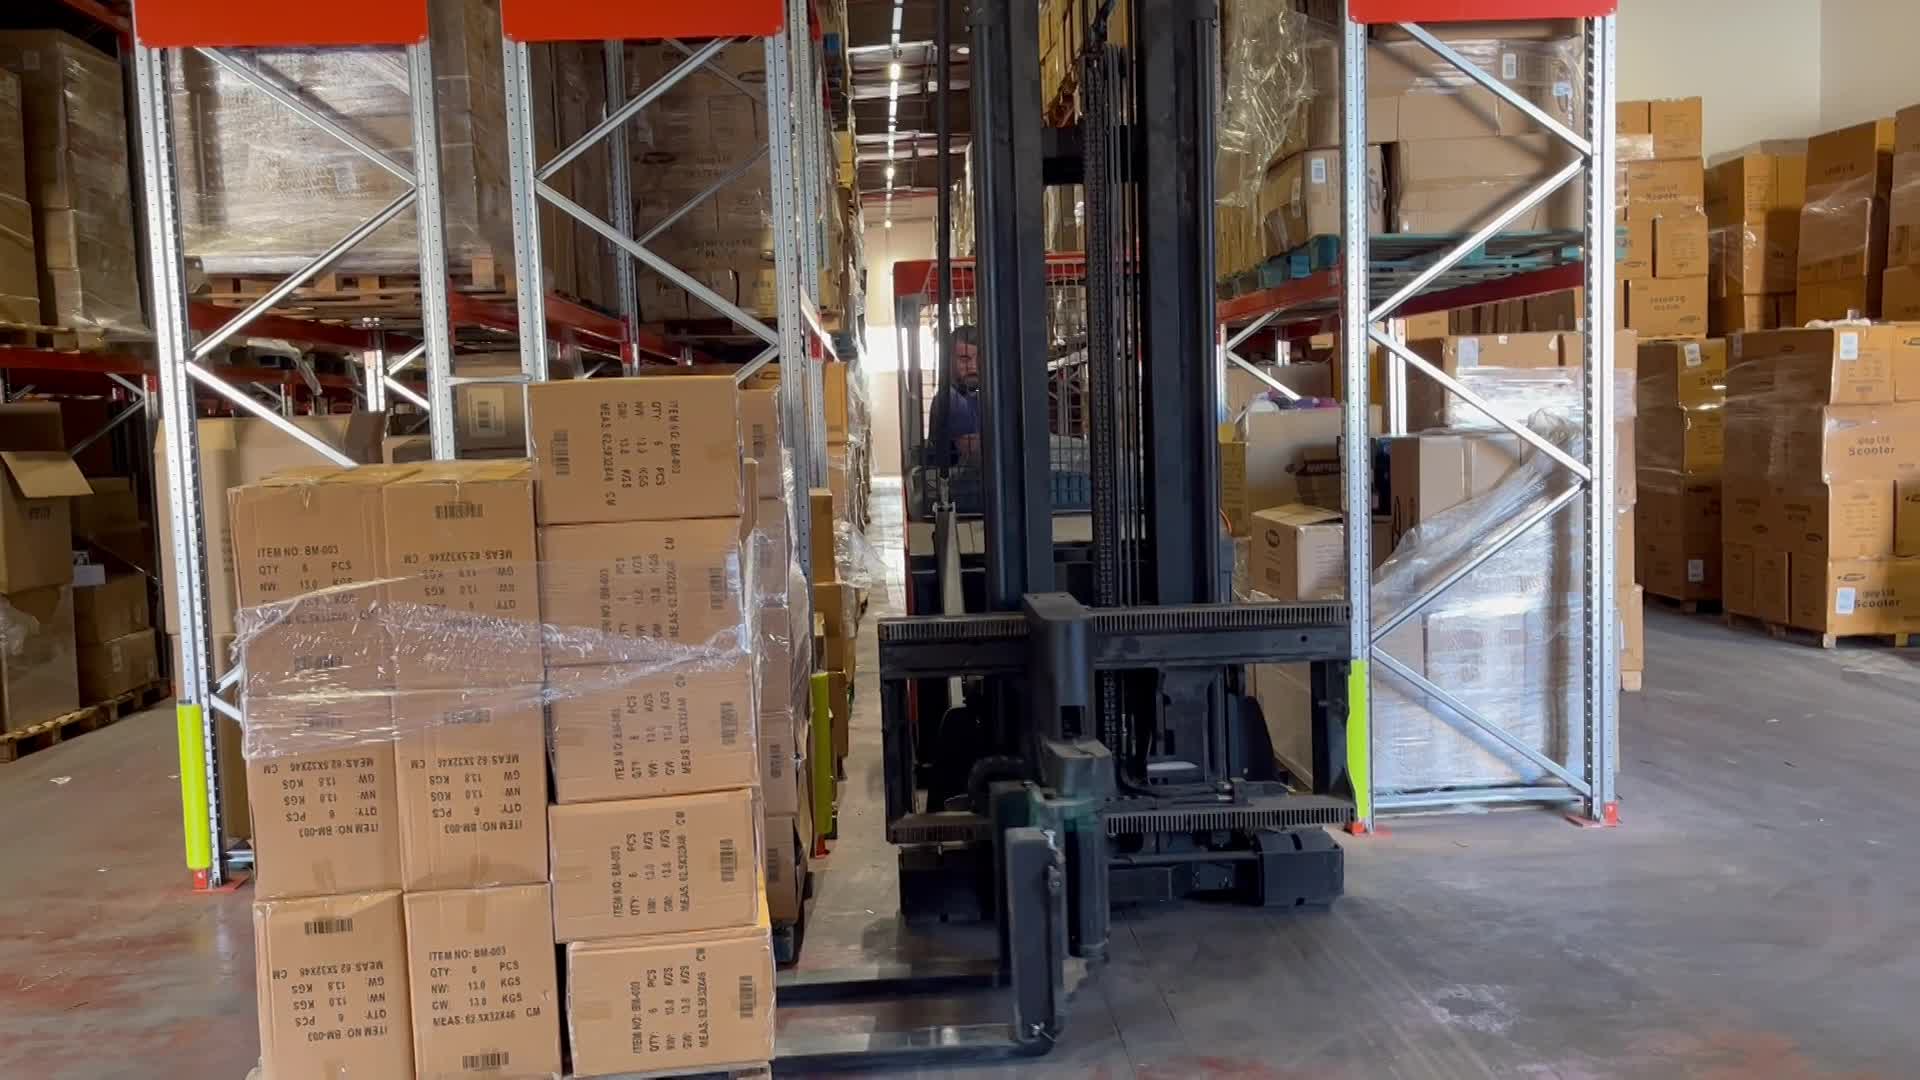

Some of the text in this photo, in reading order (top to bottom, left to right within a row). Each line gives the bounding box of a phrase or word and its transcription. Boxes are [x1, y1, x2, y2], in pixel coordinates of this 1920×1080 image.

[1848, 446, 1895, 456] Scooter
[258, 549, 281, 557] ITEM
[404, 554, 418, 563] CM
[331, 561, 352, 570] PCS
[424, 586, 445, 597] KGS
[1854, 599, 1903, 608] Scooter
[263, 764, 278, 774] CM
[411, 759, 425, 769] CM
[429, 776, 450, 785] KGS
[464, 773, 481, 783] 13.8
[282, 779, 303, 789] KGS
[320, 793, 337, 803] 13.0
[430, 791, 451, 801] KGS
[465, 789, 482, 800] 13.0
[283, 795, 305, 805] KGS
[432, 808, 452, 817] PCS
[474, 807, 480, 815] 6
[286, 812, 306, 822] PCS
[675, 811, 685, 825] CM
[335, 825, 352, 834] NO:
[355, 823, 378, 833] ITEM
[444, 820, 522, 833] ITEM NO: BM-003
[626, 833, 637, 852] PCS
[613, 896, 624, 917] ITEM
[429, 946, 506, 961] ITEM NO: BM-003
[499, 961, 519, 971] PCS
[273, 969, 287, 979] CM
[647, 969, 657, 988] PCS
[291, 984, 313, 993] KGS
[328, 982, 345, 990] 13.8
[468, 980, 486, 991] 13.0
[501, 977, 521, 988] KGS
[329, 997, 346, 1007] 13.0
[502, 993, 522, 1003] KGS
[293, 999, 314, 1010] KGS
[526, 1006, 540, 1017] CM
[295, 1016, 315, 1027] PCS
[364, 1025, 387, 1035] ITEM
[308, 1030, 341, 1041] BM-003
[633, 1032, 642, 1054] ITEM
